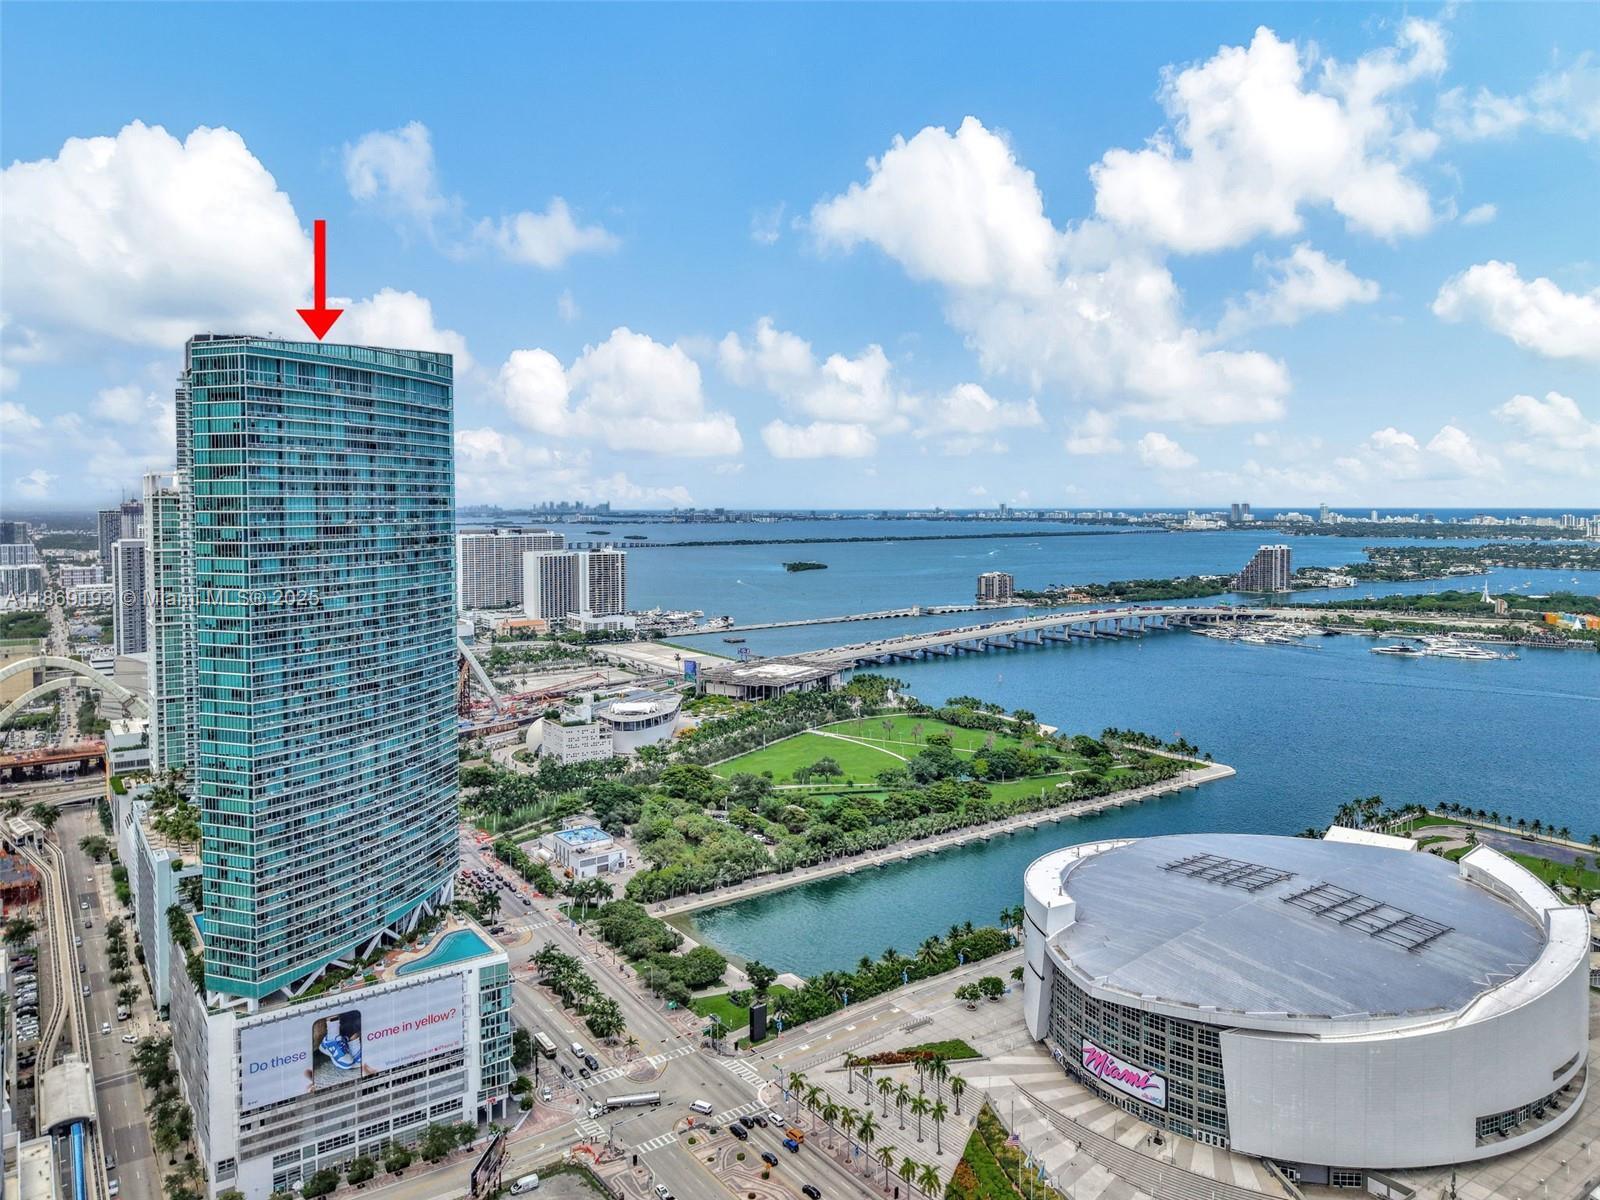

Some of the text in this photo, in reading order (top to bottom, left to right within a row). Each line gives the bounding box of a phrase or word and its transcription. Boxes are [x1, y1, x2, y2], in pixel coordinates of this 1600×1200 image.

[249, 1008, 457, 1074] Do these come in yellow?
[1081, 1047, 1161, 1090] Miami
